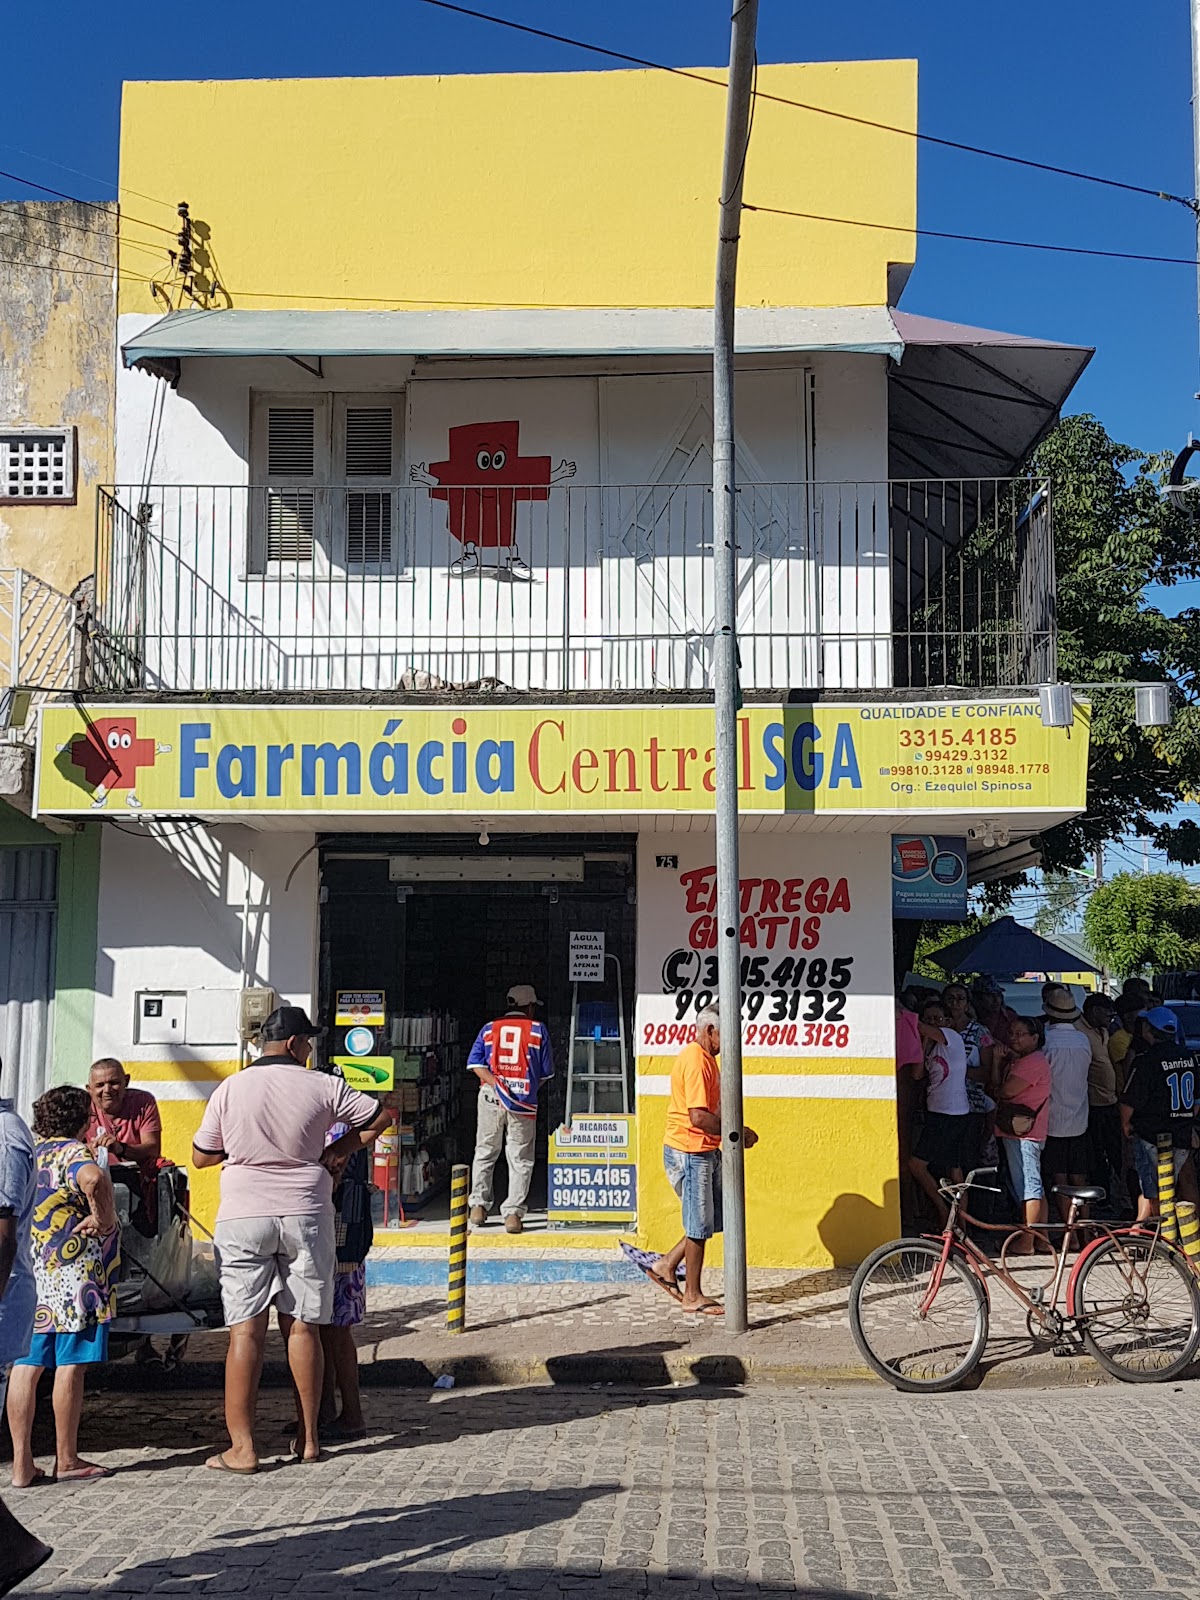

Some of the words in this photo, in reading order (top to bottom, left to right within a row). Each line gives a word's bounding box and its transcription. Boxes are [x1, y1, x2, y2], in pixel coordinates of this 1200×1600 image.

[860, 706, 947, 720] QUALIDADE
[952, 706, 960, 718] E
[966, 704, 1042, 719] CONFIANÇ
[899, 728, 1017, 747] 3315.4185
[180, 718, 515, 799] Farmácia
[763, 721, 863, 792] SGA
[925, 749, 1008, 762] 99429.3132
[891, 765, 963, 776] 99810.3128
[976, 764, 1051, 775] 98948.1778
[925, 781, 978, 793] Ezequiel
[981, 781, 1032, 793] Spinosa
[660, 856, 673, 868] 75
[702, 956, 854, 989] 315.4185
[499, 1026, 522, 1064] 9
[1161, 1058, 1194, 1071] Banrisul
[1166, 1071, 1194, 1111] 10
[579, 1122, 618, 1132] RECARGAS
[573, 1134, 592, 1144] PARA
[553, 1168, 631, 1186] 3315.4185
[553, 1188, 631, 1207] 99429.3132
